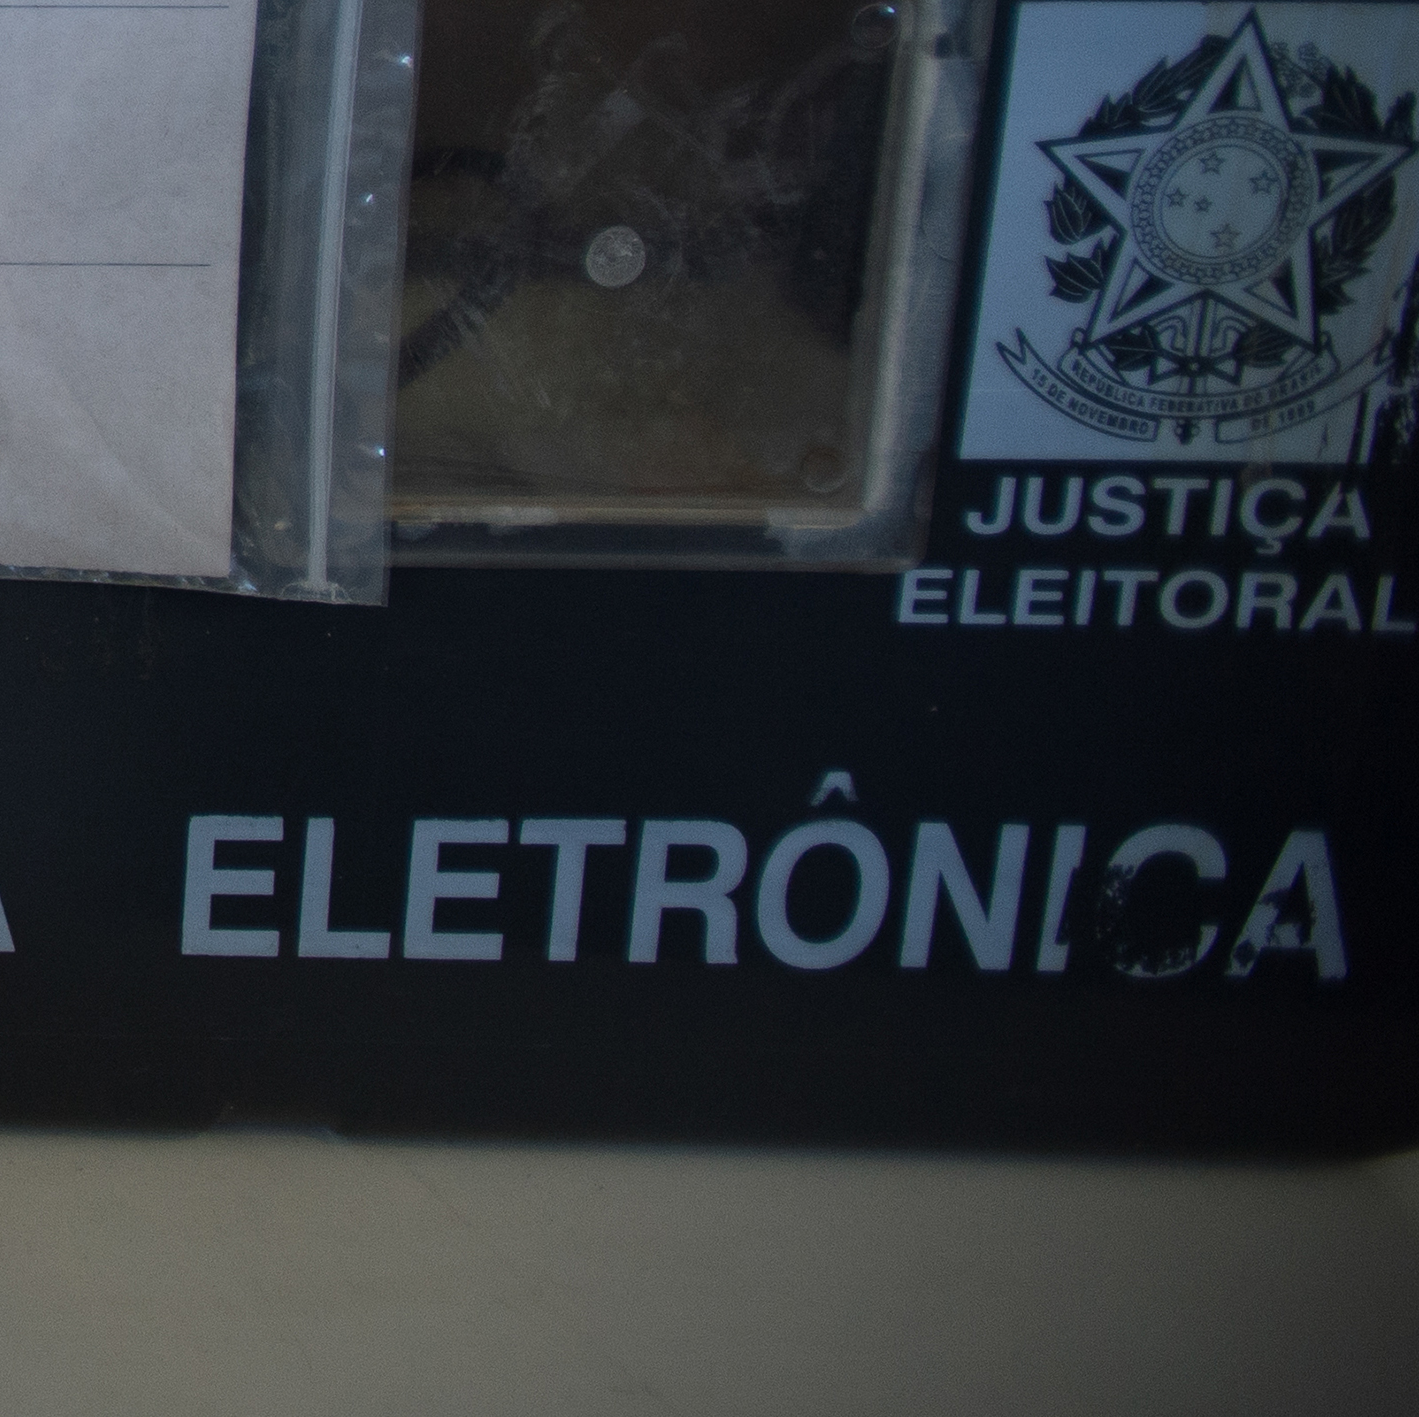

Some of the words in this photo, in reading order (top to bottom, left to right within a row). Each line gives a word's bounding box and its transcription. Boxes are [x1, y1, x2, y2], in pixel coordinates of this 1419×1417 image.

[1047, 382, 1065, 401] DE
[1068, 397, 1149, 434] NOVEMBRO
[964, 475, 1371, 554] JUSTIÇA
[897, 568, 1416, 632] ELEITORAL
[180, 770, 1349, 980] ELETRÔNICA
